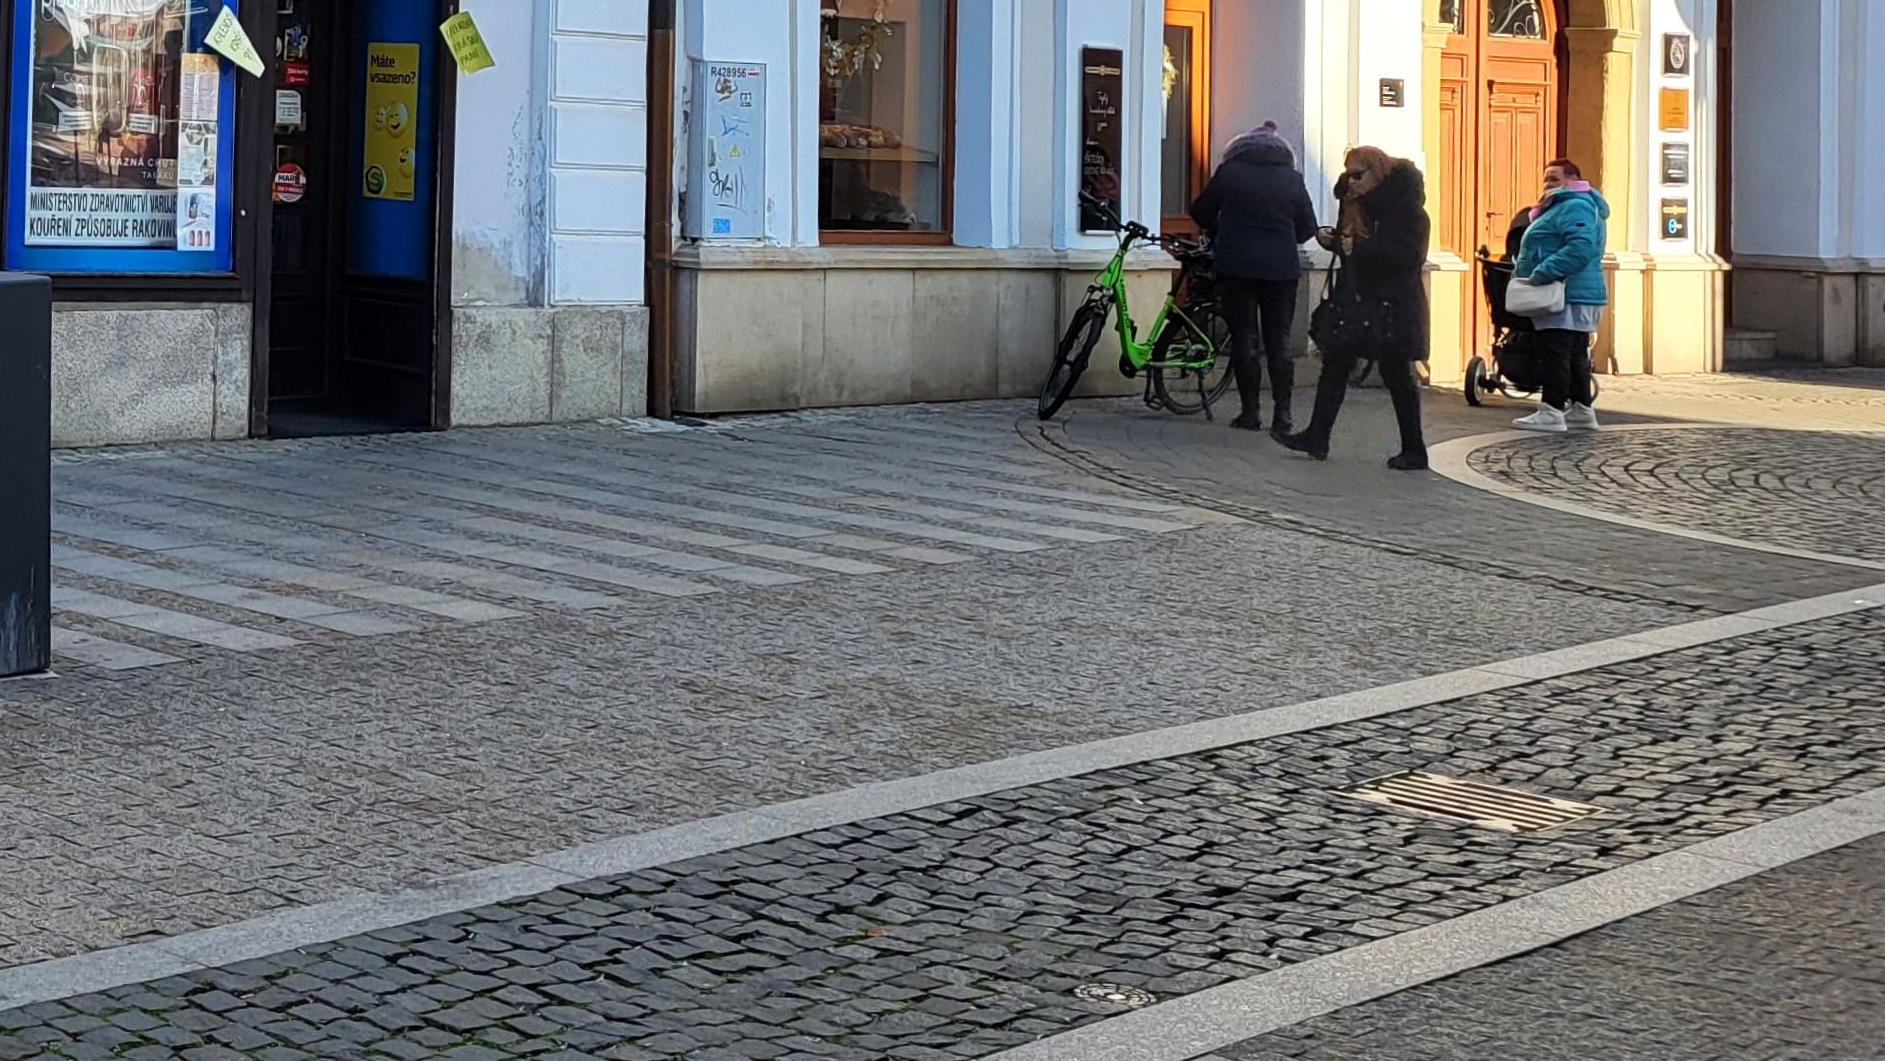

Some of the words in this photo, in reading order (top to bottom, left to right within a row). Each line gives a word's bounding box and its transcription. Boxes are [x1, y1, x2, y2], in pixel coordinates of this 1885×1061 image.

[370, 54, 396, 68] Máte
[370, 70, 416, 85] vsazeno?
[710, 66, 747, 78] R428956
[30, 191, 88, 213] MINISTERSTVO
[89, 191, 148, 213] ZDRAVOTNICTVÍ
[150, 194, 177, 214] VARUJE
[29, 214, 73, 238] KOUŘENÍ
[75, 215, 129, 239] ZPŮSOBUJE
